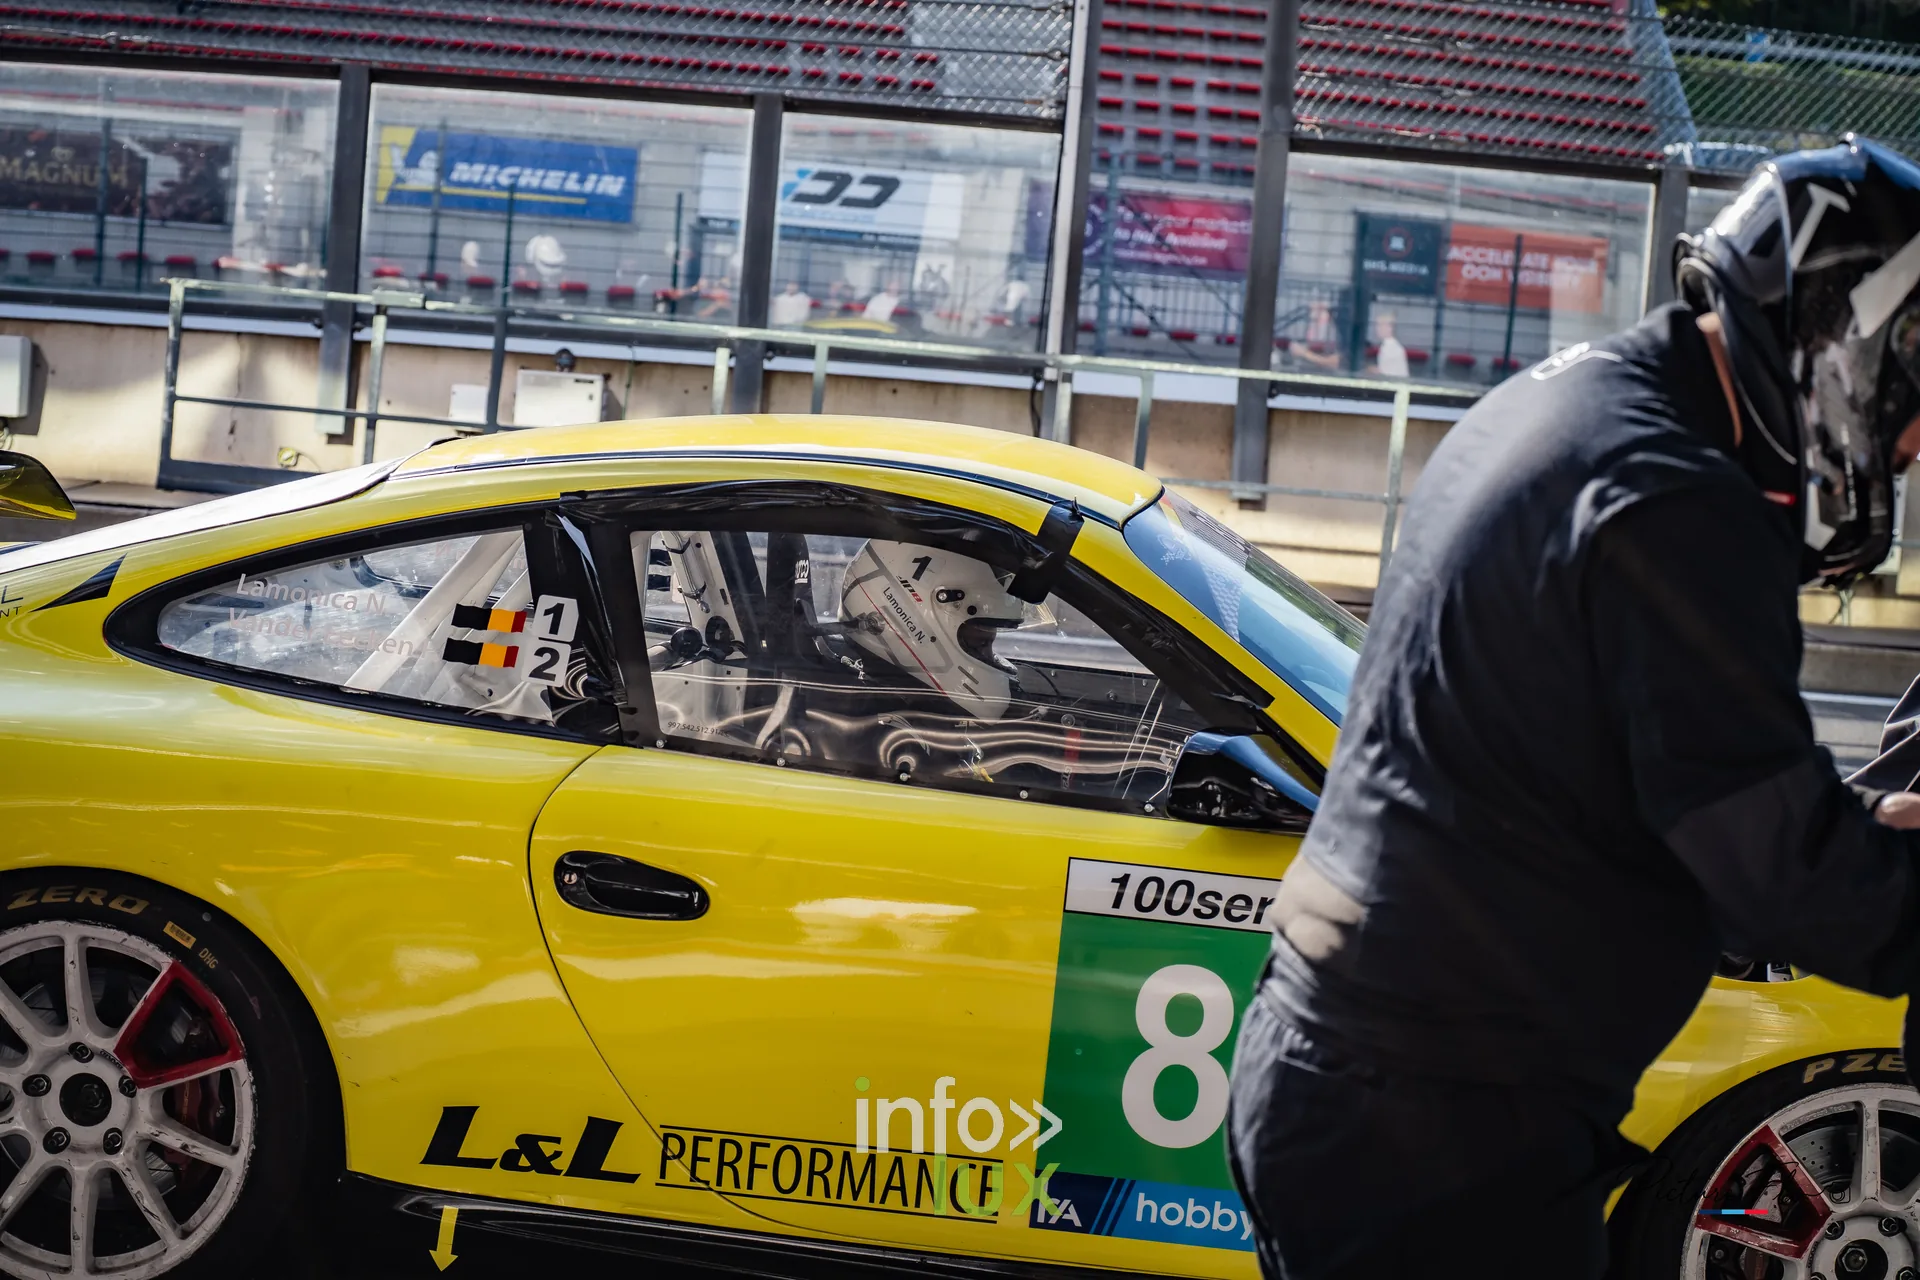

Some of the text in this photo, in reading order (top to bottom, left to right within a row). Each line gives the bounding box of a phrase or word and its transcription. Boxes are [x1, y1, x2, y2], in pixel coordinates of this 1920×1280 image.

[0, 156, 128, 189] MAGNUM
[450, 162, 626, 197] MICHELIN
[1447, 246, 1549, 267] ACCELEATE
[911, 556, 932, 582] 1
[236, 573, 358, 611] Lamonica
[229, 607, 314, 641] Vander
[543, 602, 565, 636] 1
[883, 586, 926, 644] Lamonica N.
[528, 646, 560, 682] 2
[7, 885, 149, 915] ZERO
[198, 947, 219, 969] DHG
[1121, 963, 1234, 1149] 8
[1803, 1057, 1835, 1084] P
[419, 1105, 1004, 1216] L&L PERFORMANCE
